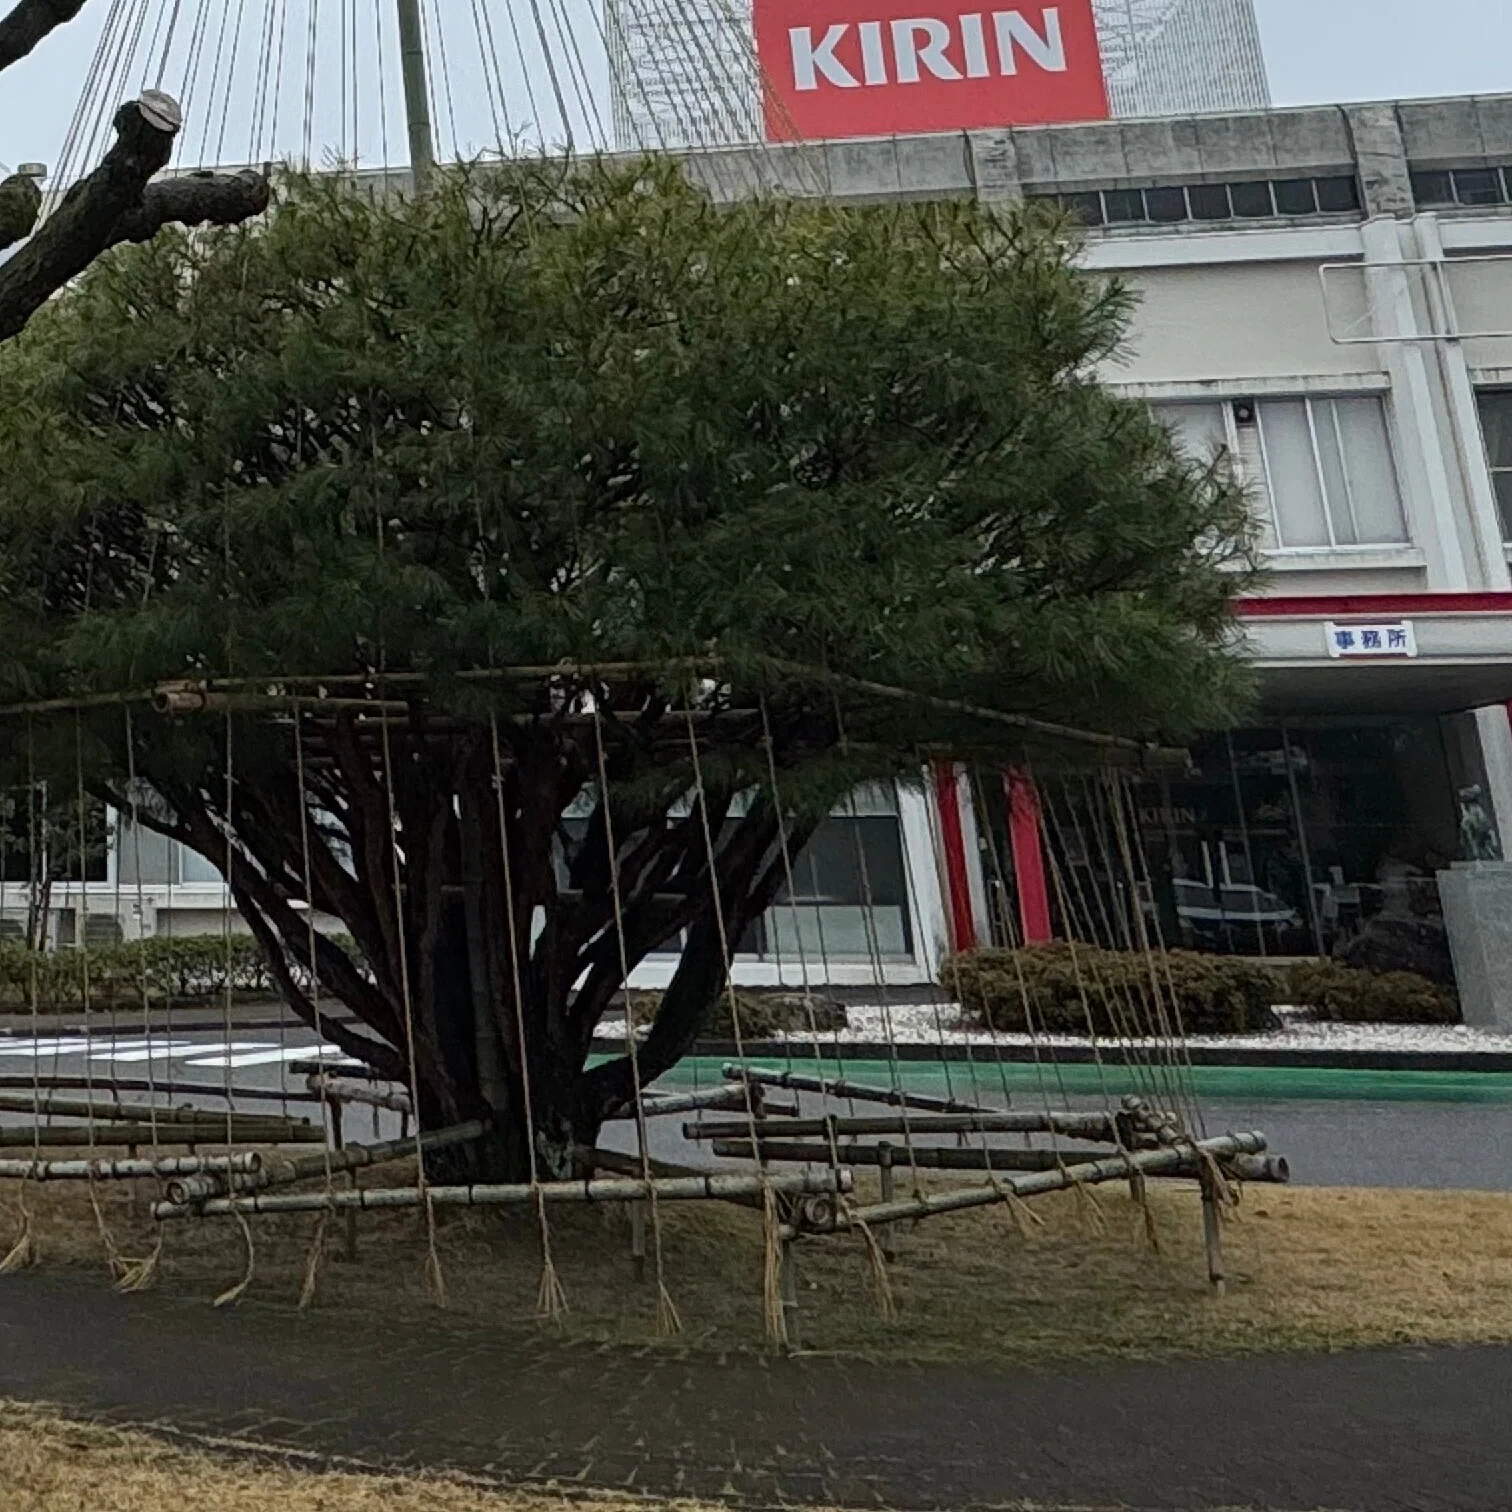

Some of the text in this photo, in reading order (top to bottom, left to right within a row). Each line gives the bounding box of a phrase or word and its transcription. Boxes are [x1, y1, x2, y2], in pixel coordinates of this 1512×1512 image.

[789, 7, 1067, 90] KIRIN
[1334, 628, 1407, 650] 事務所
